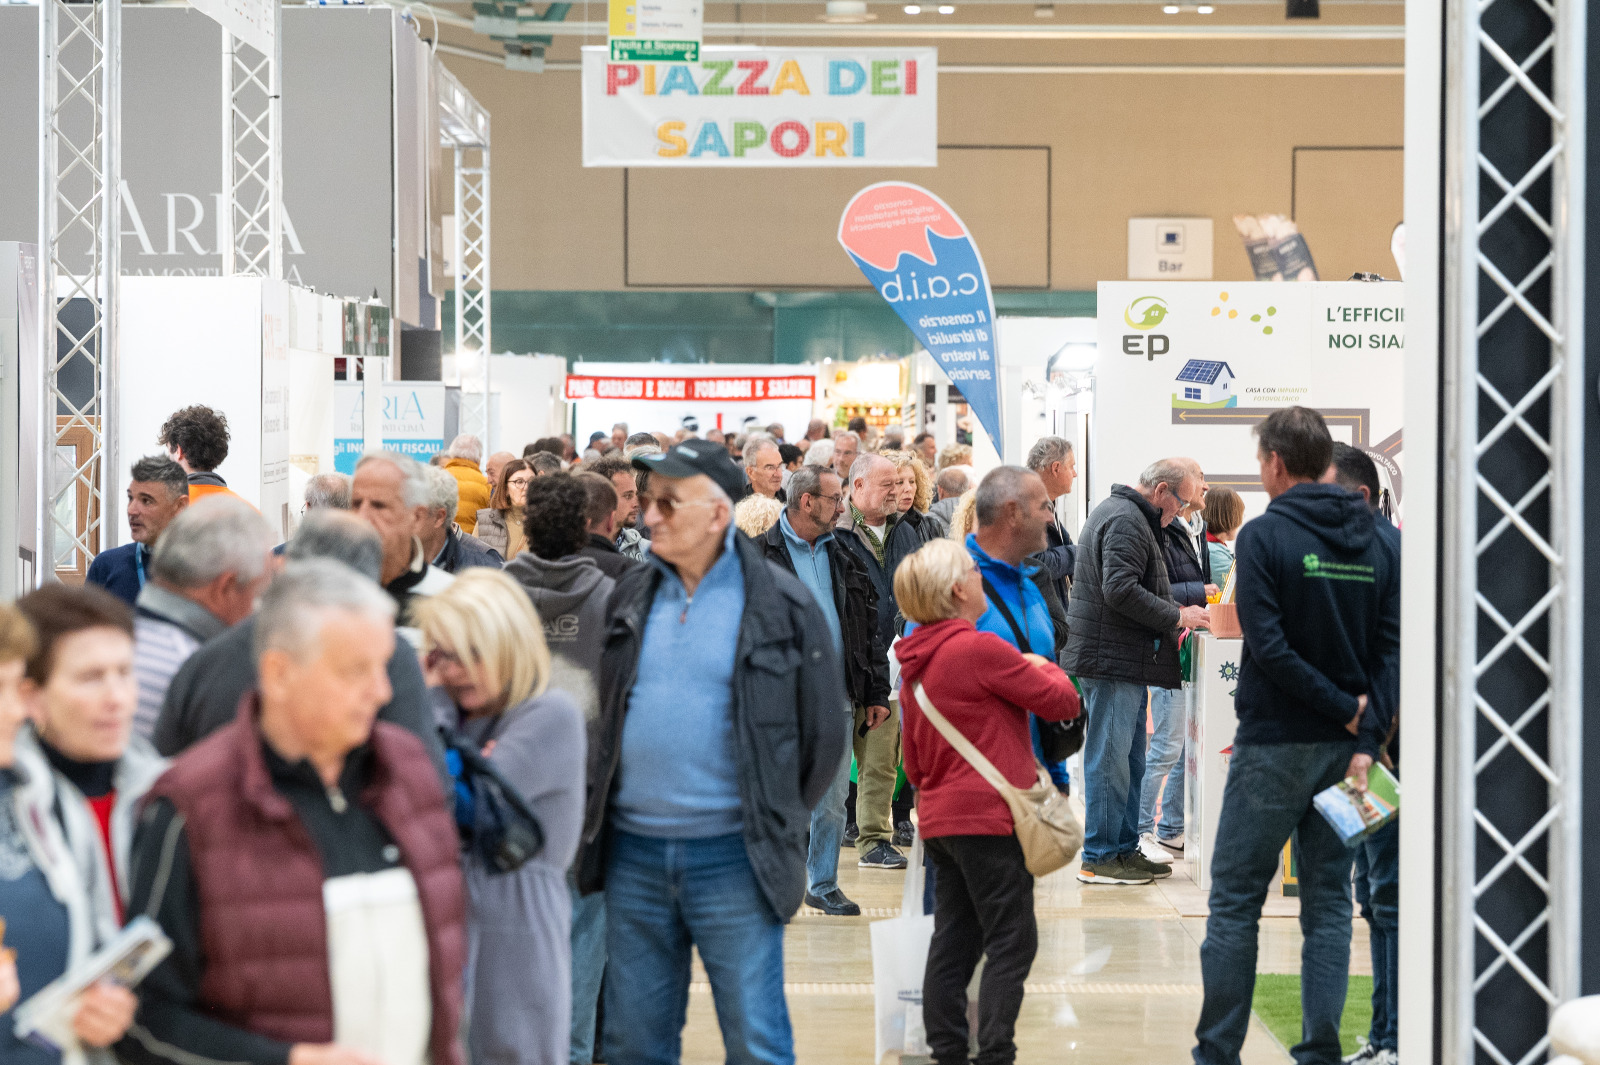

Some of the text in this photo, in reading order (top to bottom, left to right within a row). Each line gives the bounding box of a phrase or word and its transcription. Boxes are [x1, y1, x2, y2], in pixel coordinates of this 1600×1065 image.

[606, 60, 917, 96] PIAZZA DEI
[657, 121, 866, 158] SAPORI
[1158, 260, 1183, 272] Bar
[1328, 334, 1404, 348] NOI SIA
[402, 443, 440, 454] FISCALI
